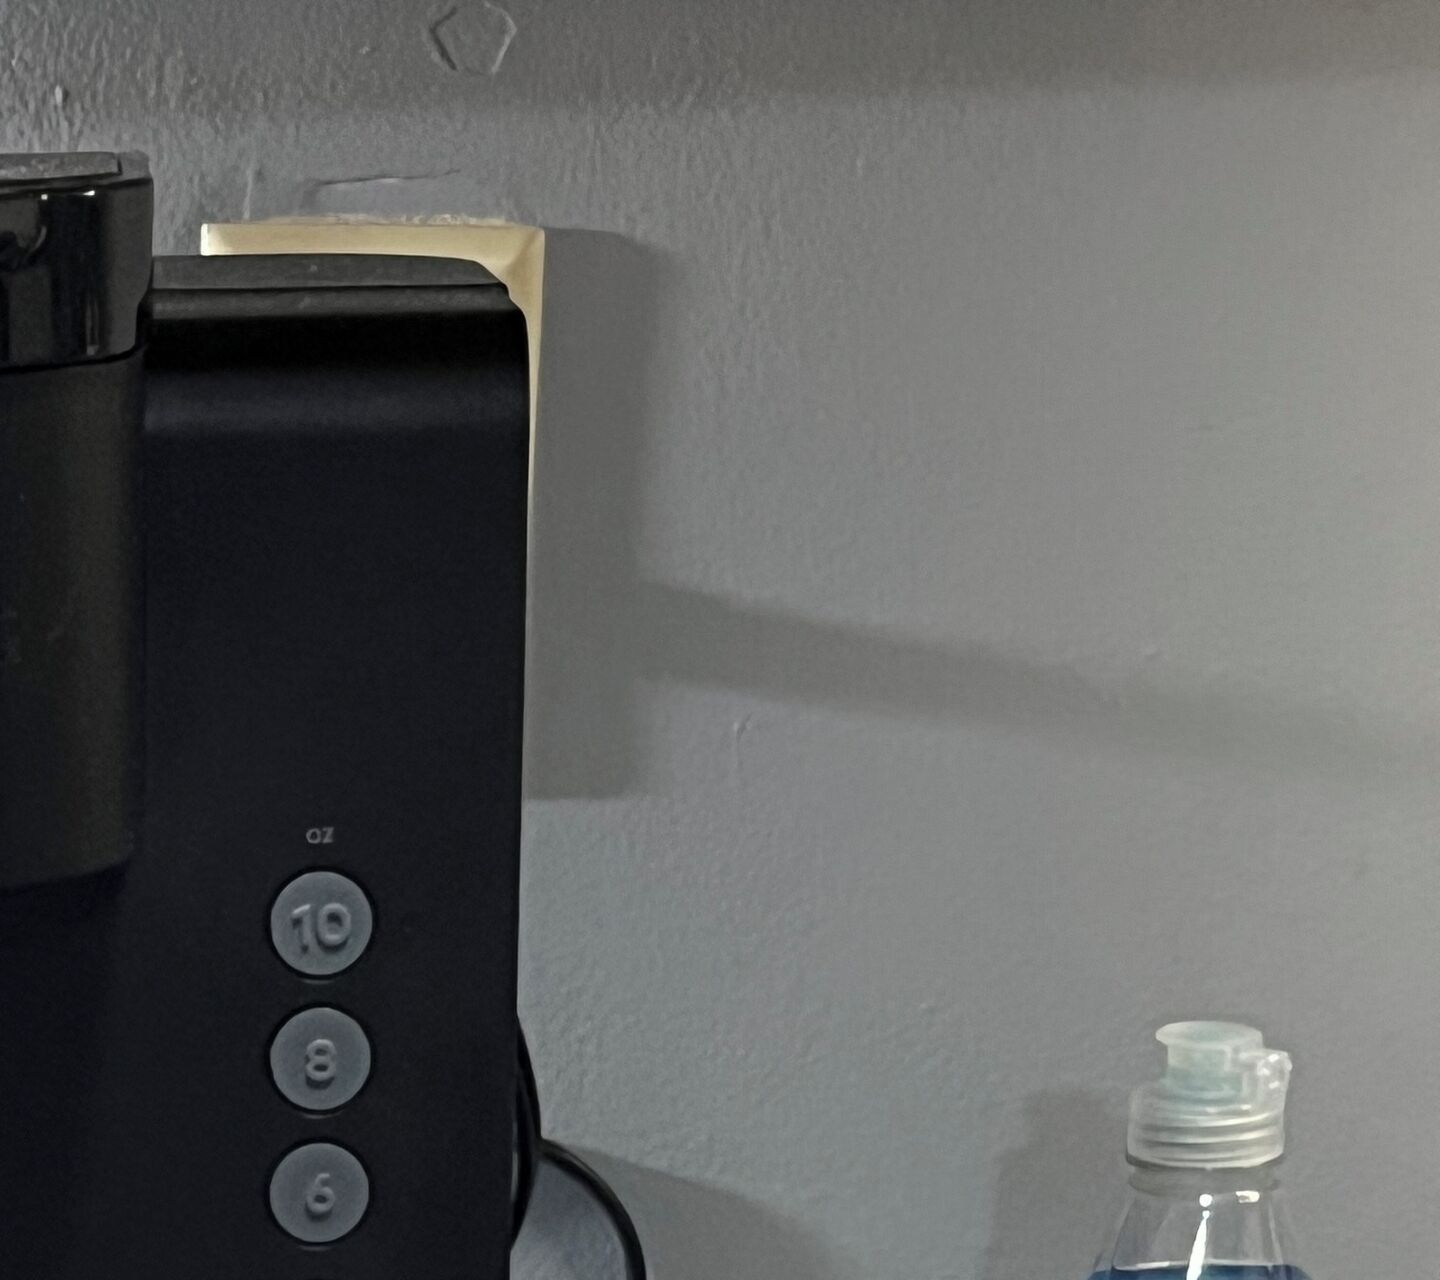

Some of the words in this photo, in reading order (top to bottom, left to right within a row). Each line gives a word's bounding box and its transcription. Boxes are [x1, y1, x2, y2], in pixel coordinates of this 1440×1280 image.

[291, 902, 352, 950] 10
[306, 1038, 337, 1084] 8
[306, 1173, 336, 1216] 6
